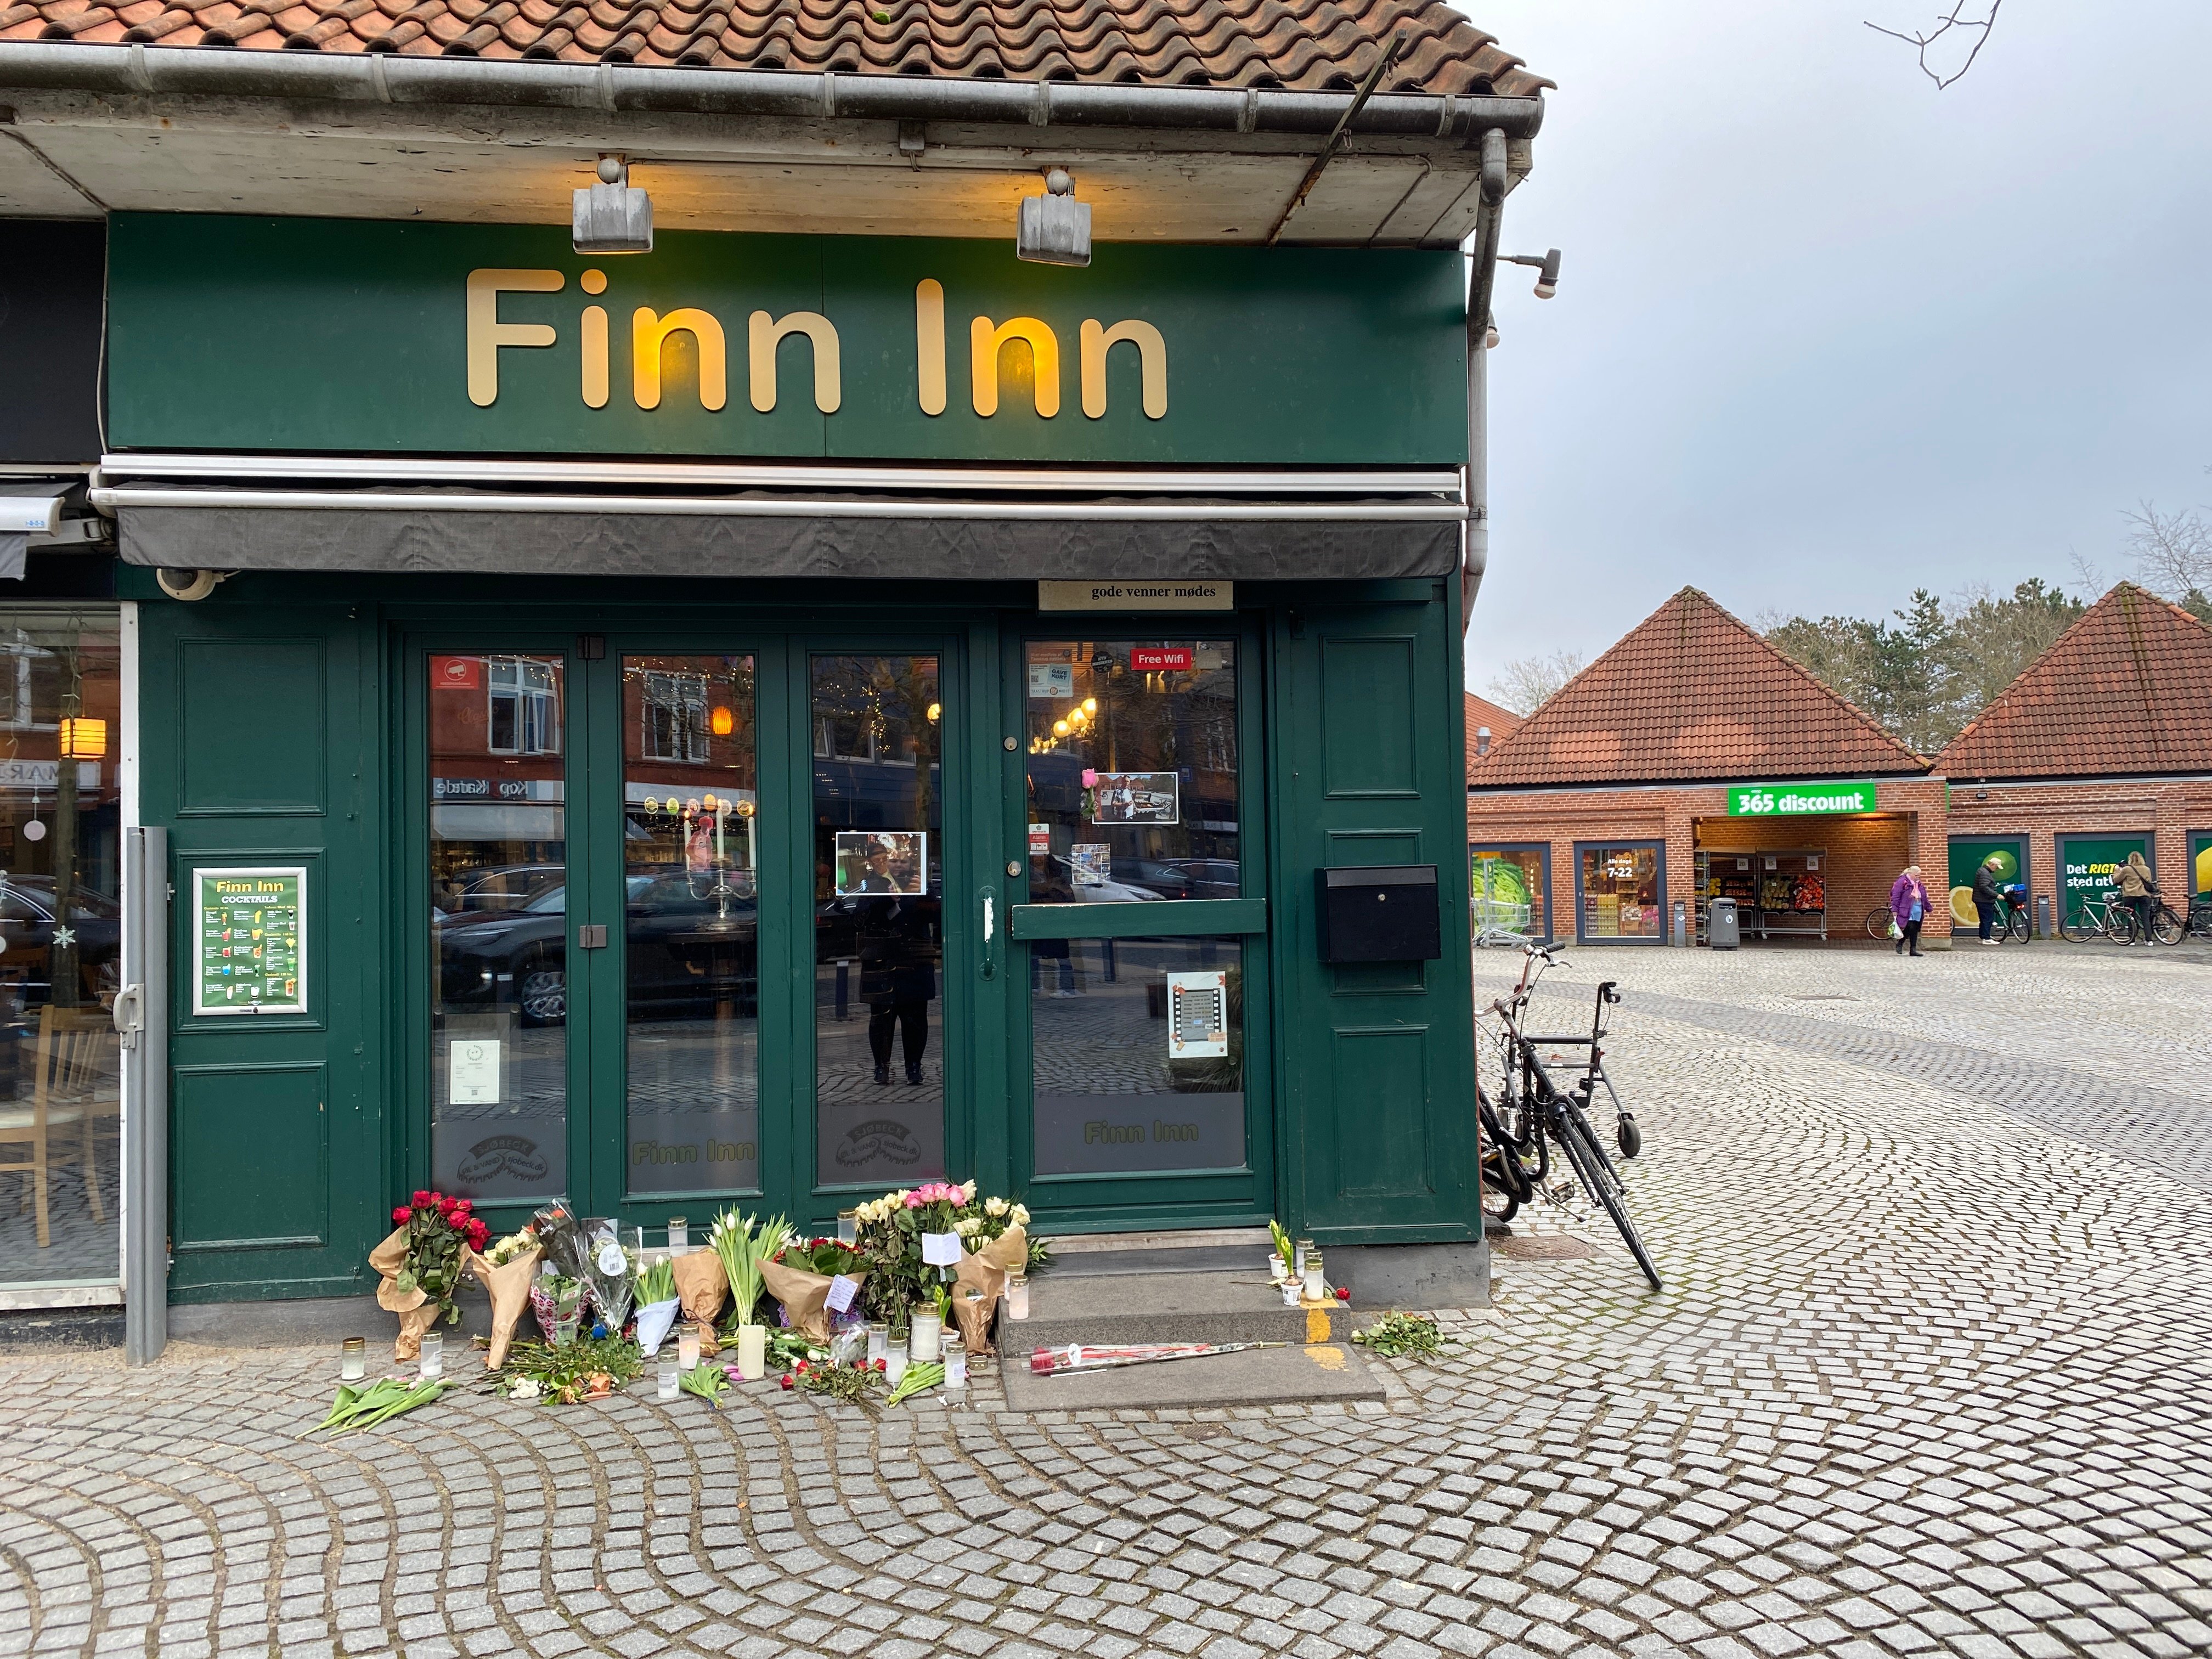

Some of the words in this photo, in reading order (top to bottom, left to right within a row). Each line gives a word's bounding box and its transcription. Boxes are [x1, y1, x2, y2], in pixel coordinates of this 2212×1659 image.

[466, 268, 841, 413] Finn
[916, 278, 1167, 419] Inn
[1092, 585, 1122, 600] gode
[1126, 588, 1171, 597] venner
[1175, 585, 1216, 598] mødes
[1138, 654, 1161, 664] Free
[1164, 654, 1184, 664] Wifi
[1739, 794, 1775, 813] 365
[1779, 792, 1865, 811] discount
[1607, 867, 1633, 878] 7-22
[2067, 864, 2087, 874] Det
[2089, 864, 2117, 874] RIGT
[216, 880, 252, 893] Finn
[257, 880, 284, 893] Inn
[2067, 876, 2094, 887] sted
[2095, 877, 2109, 887] at
[221, 895, 278, 904] COCKTAILS
[854, 1124, 904, 1138] SJØBECK
[1085, 1120, 1146, 1144] Finn
[1154, 1120, 1199, 1142] Inn
[477, 1139, 529, 1154] SJØBECK
[632, 1141, 697, 1165] Finn
[706, 1138, 755, 1162] Inn
[857, 1141, 876, 1152] VAND
